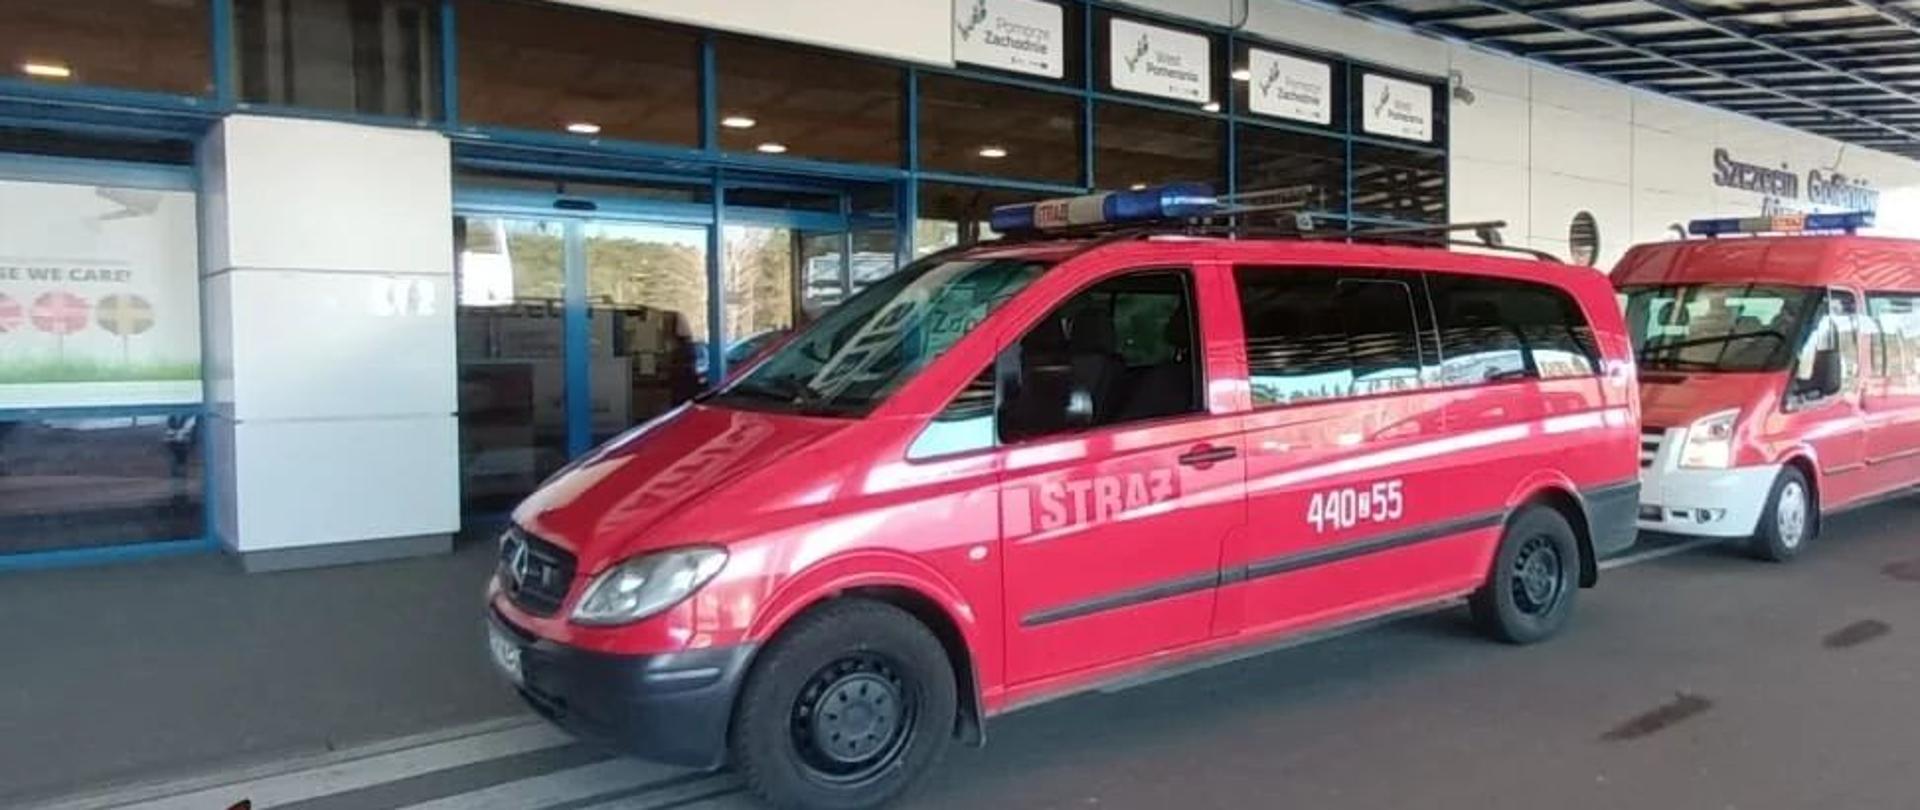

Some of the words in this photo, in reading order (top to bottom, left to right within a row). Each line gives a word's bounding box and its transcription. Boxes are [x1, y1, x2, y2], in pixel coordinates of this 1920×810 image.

[984, 30, 1047, 54] Zachodnie
[1713, 147, 1798, 199] Szczecin
[26, 267, 62, 282] WE
